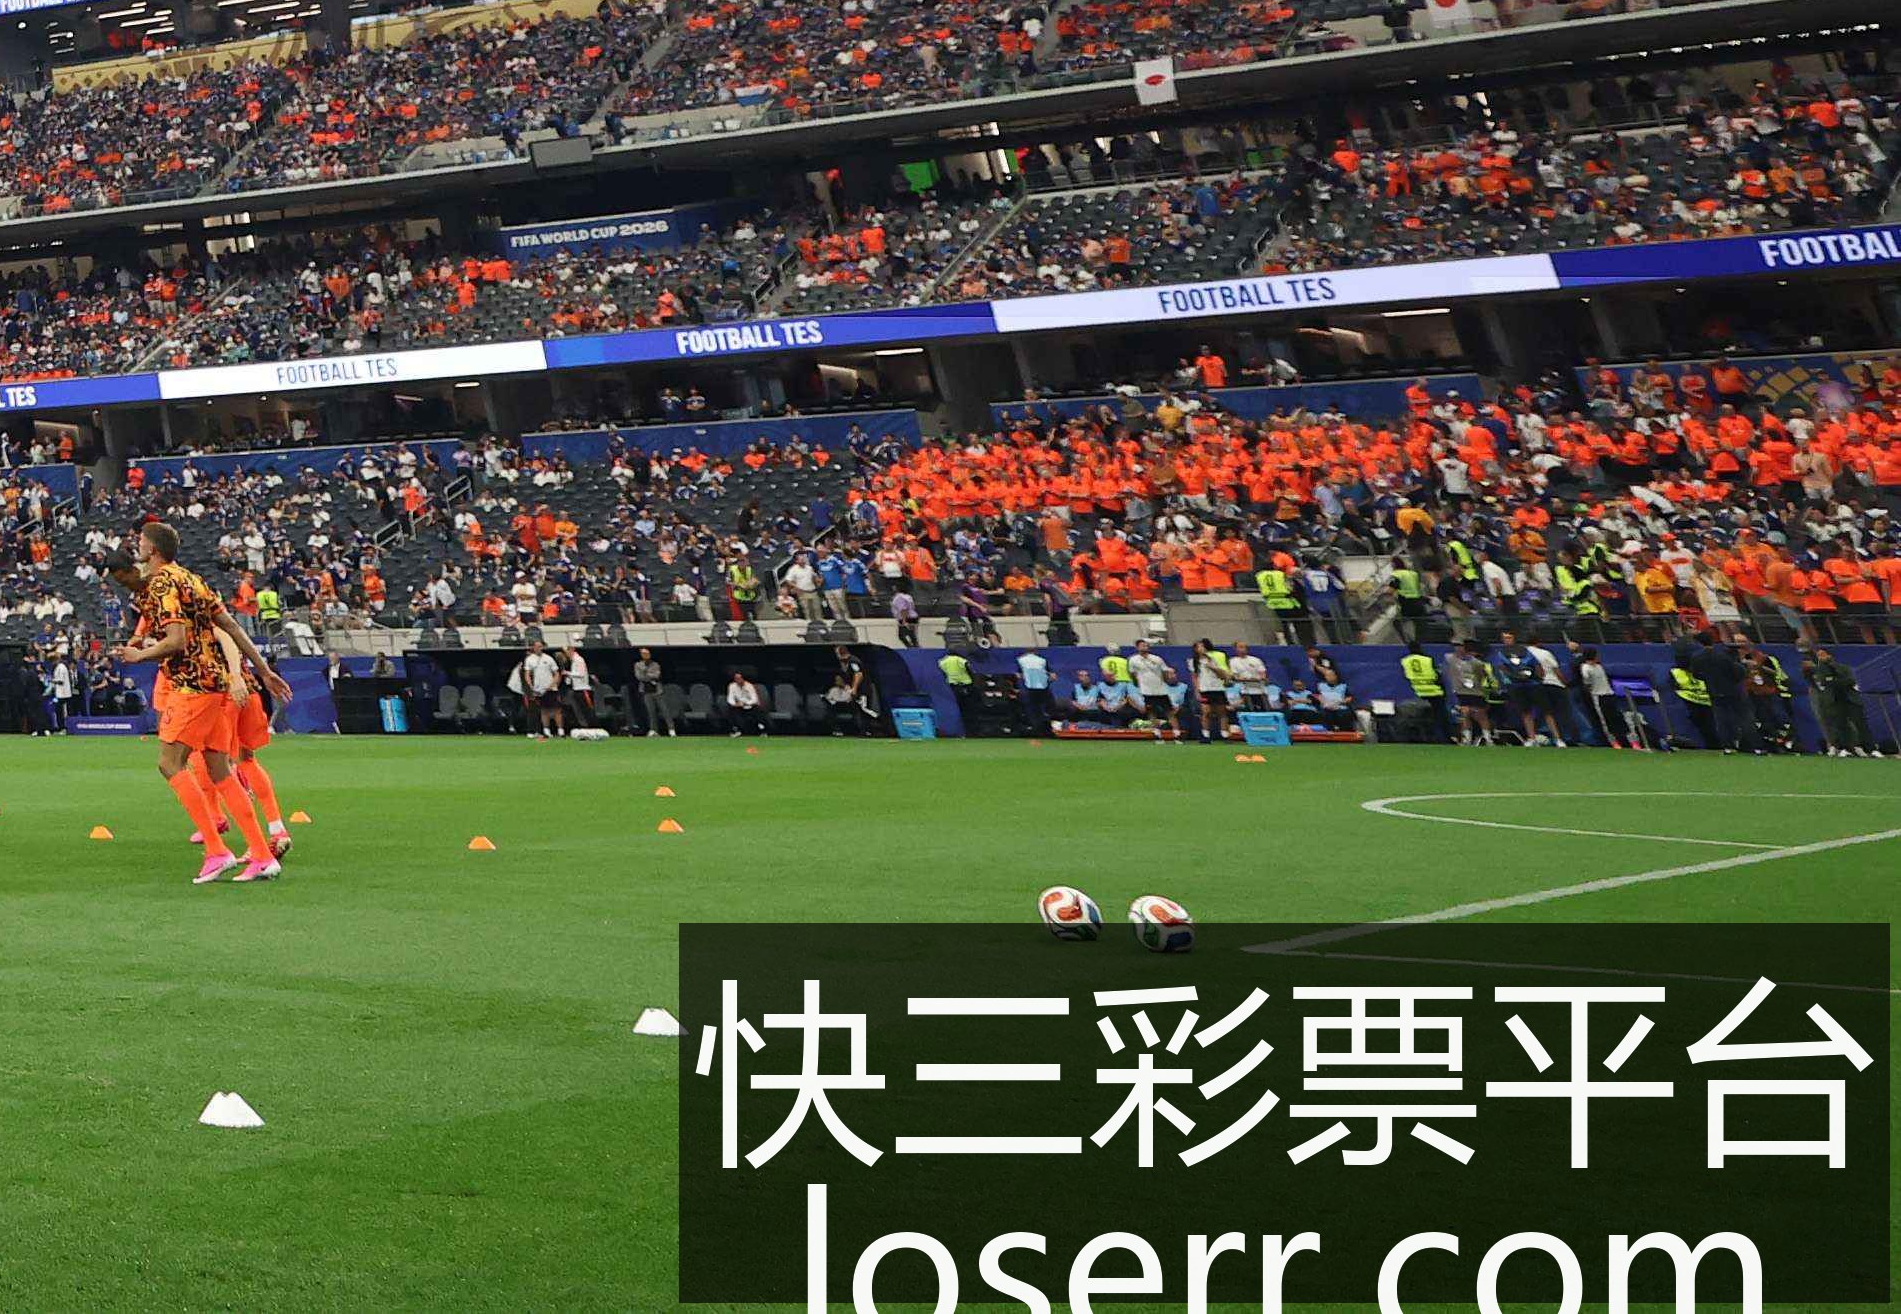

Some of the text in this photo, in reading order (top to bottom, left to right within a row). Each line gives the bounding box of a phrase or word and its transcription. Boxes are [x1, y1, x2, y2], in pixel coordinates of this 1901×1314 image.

[511, 220, 669, 248] FIFA WORLD CUP 2026
[1159, 278, 1335, 314] FOOTBALL TES
[676, 321, 822, 353] FOOTBALL TES
[276, 358, 397, 384] FOOTBALL TES
[7, 387, 36, 406] TES
